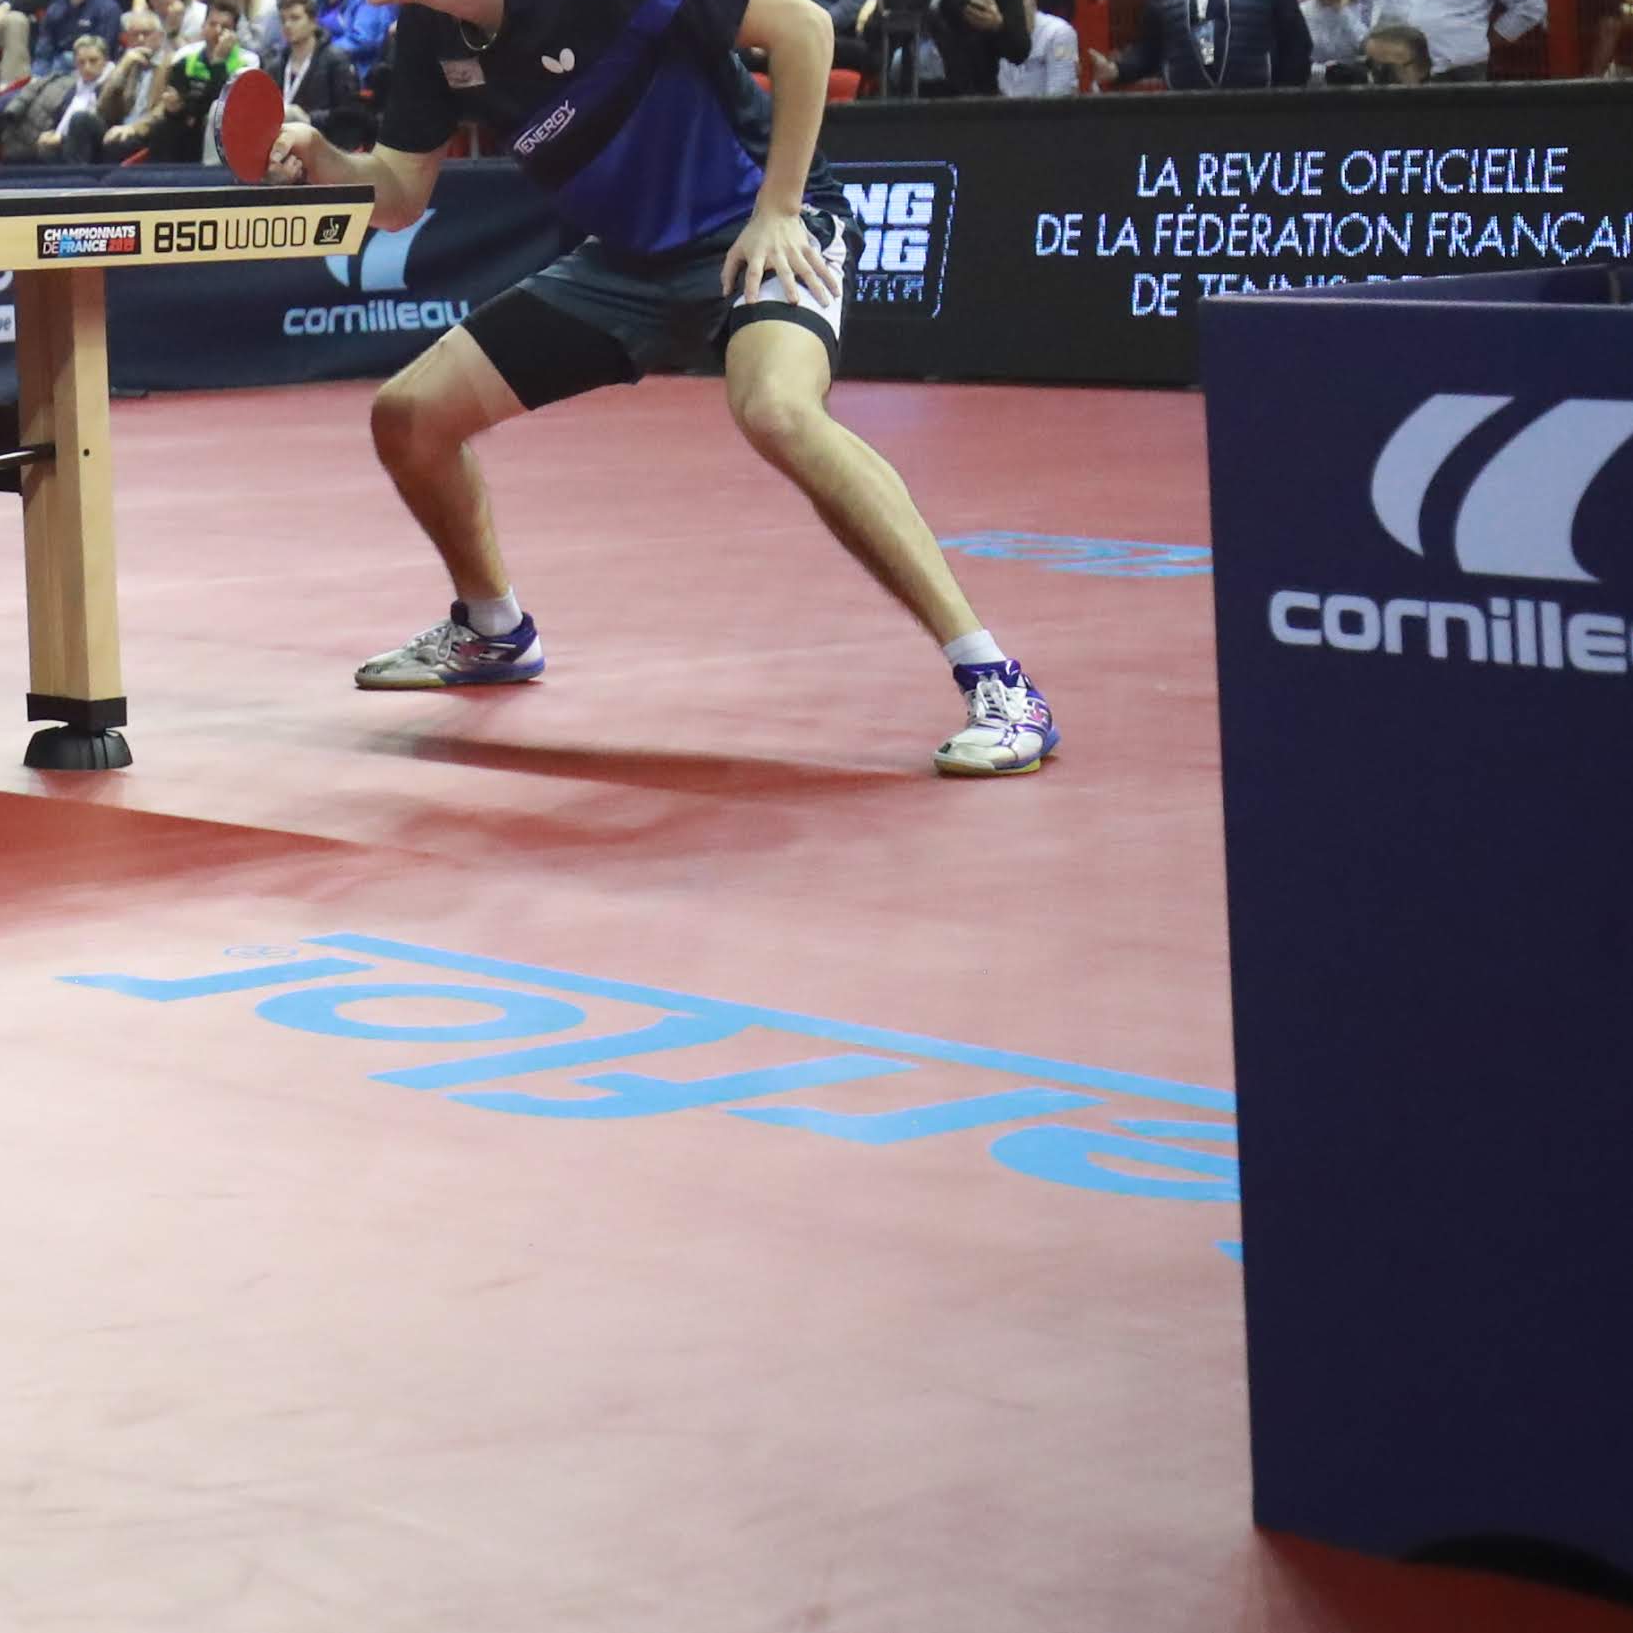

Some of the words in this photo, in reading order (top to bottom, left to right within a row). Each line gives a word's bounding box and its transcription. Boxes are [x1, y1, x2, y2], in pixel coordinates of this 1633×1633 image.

[514, 100, 575, 156] TENERGY
[1136, 154, 1181, 198] LA
[1197, 150, 1327, 197] REVUE
[1340, 147, 1569, 196] OFFICIELLE
[42, 241, 60, 255] DE
[59, 240, 108, 253] FRANCE
[43, 225, 136, 241] CHAMPIONNATS
[154, 220, 218, 254] 850
[224, 216, 307, 250] WOOD
[1035, 213, 1084, 257] DE
[1095, 213, 1141, 257] LA
[1154, 203, 1414, 258] FÉDÉRATION
[1425, 211, 1633, 266] FRANÇAI
[283, 299, 470, 336] cornilleau
[1131, 272, 1182, 317] DE
[1268, 589, 1633, 674] cornille
[54, 934, 1242, 1261] erflor
